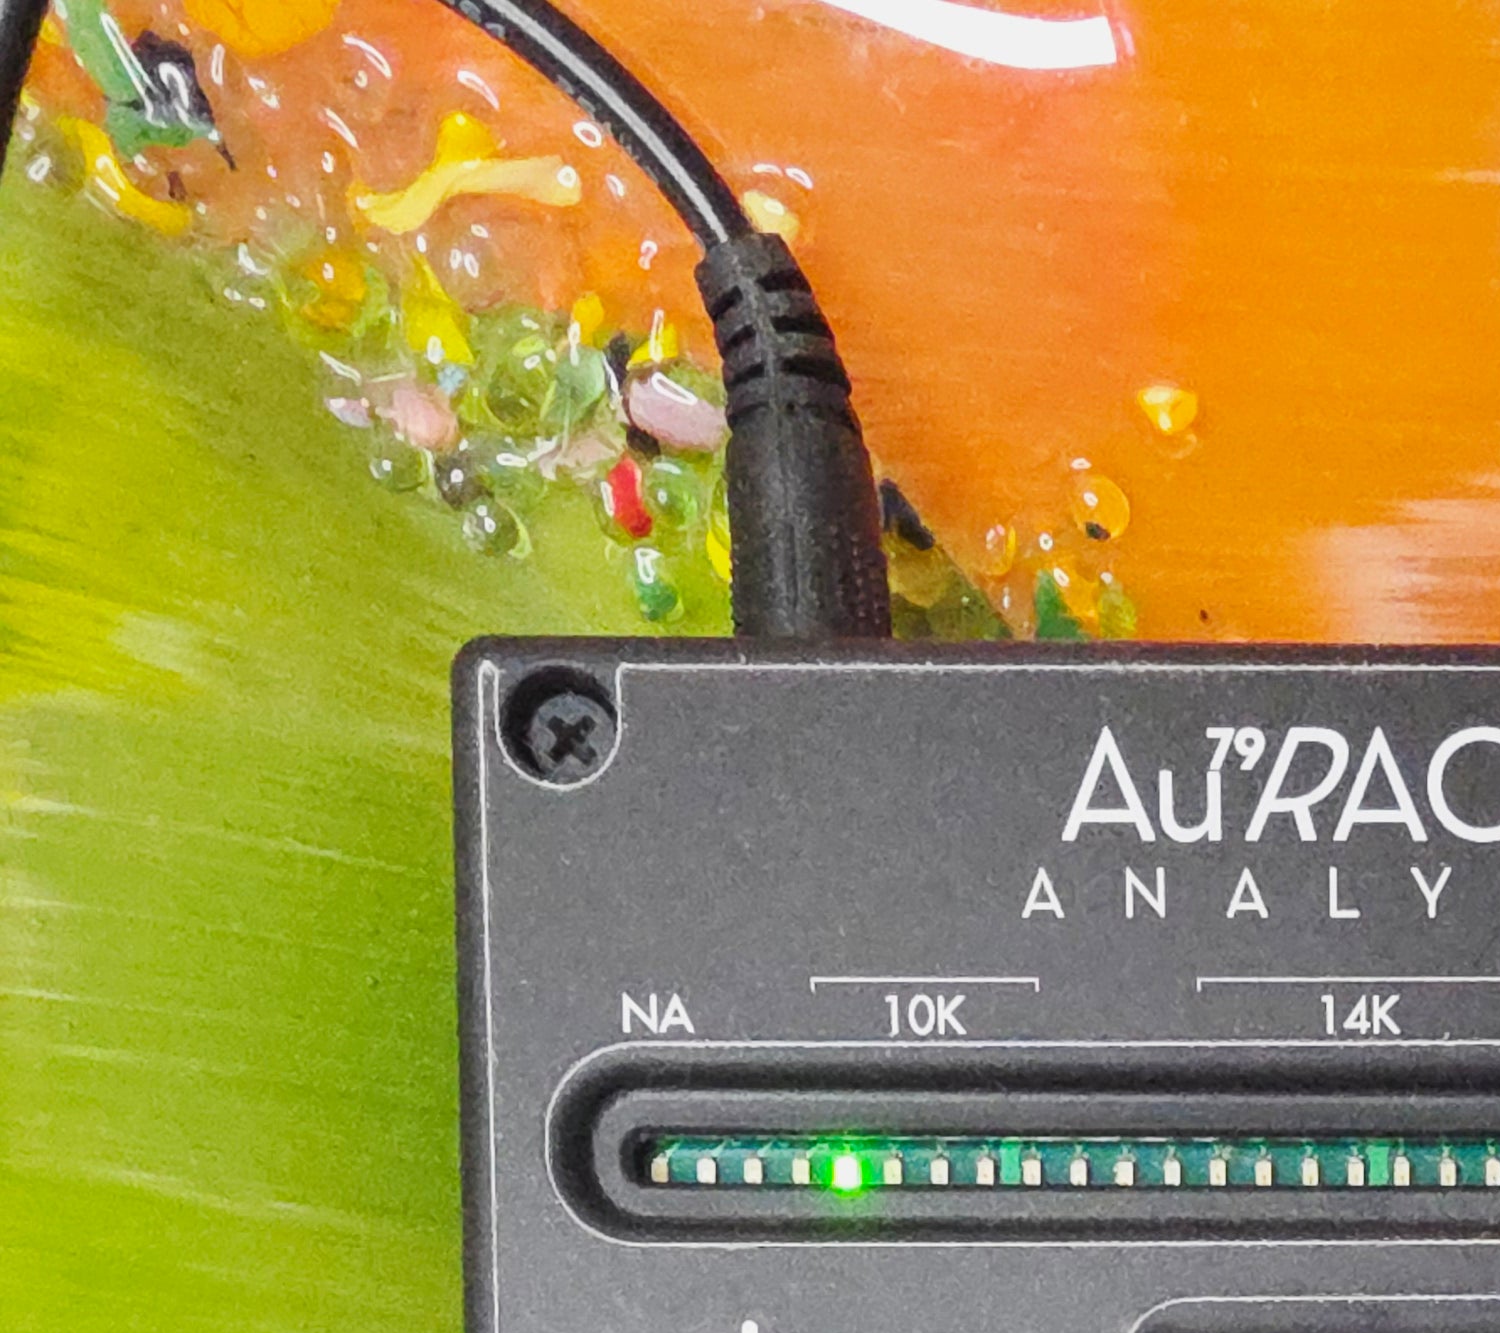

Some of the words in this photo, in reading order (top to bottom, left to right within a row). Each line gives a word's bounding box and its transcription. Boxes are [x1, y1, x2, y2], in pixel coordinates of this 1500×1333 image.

[620, 991, 696, 1035] NA
[883, 994, 968, 1037] 10K
[1319, 992, 1401, 1035] 14K
